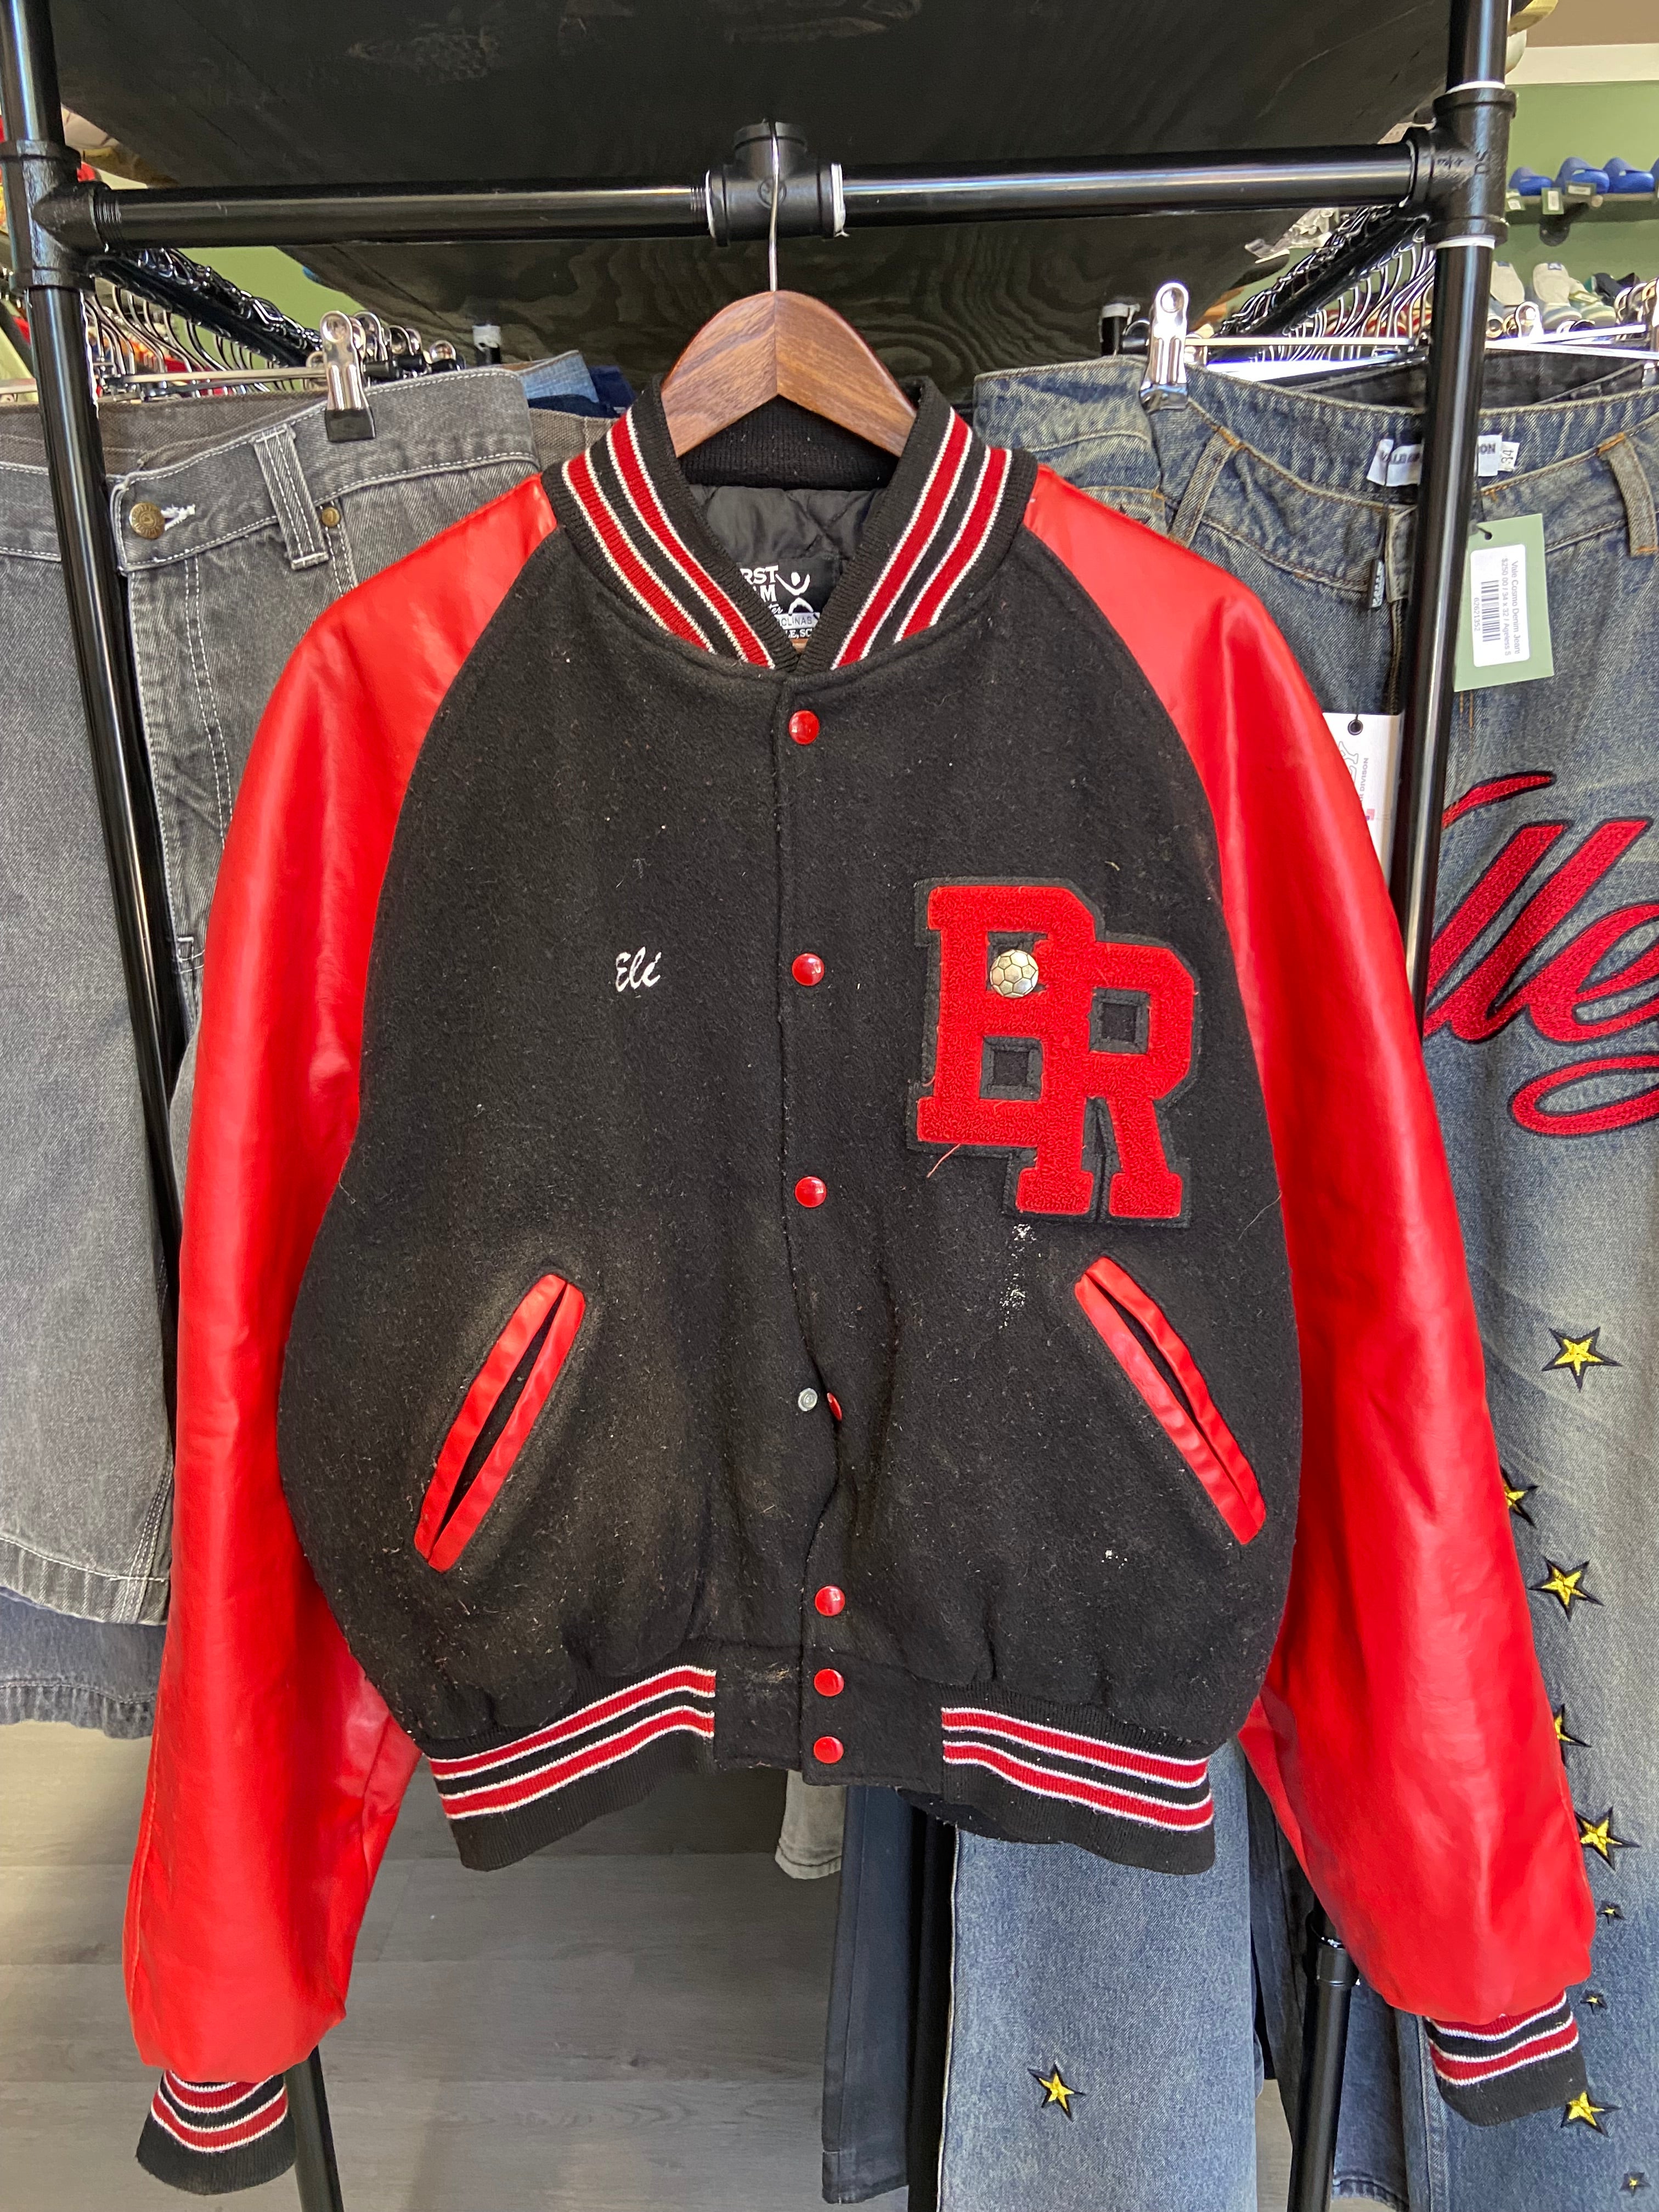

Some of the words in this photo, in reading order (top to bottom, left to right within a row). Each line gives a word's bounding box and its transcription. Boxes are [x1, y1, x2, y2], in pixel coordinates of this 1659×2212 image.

[1501, 450, 1514, 464] 34
[739, 565, 778, 584] RST
[1510, 561, 1519, 578] Vale
[1511, 580, 1519, 606] Cosmo
[768, 603, 783, 614] ter
[1511, 608, 1520, 632] Denim
[1502, 623, 1511, 650] Ageless
[1359, 758, 1369, 792] DIVISON
[614, 946, 662, 992] Eli
